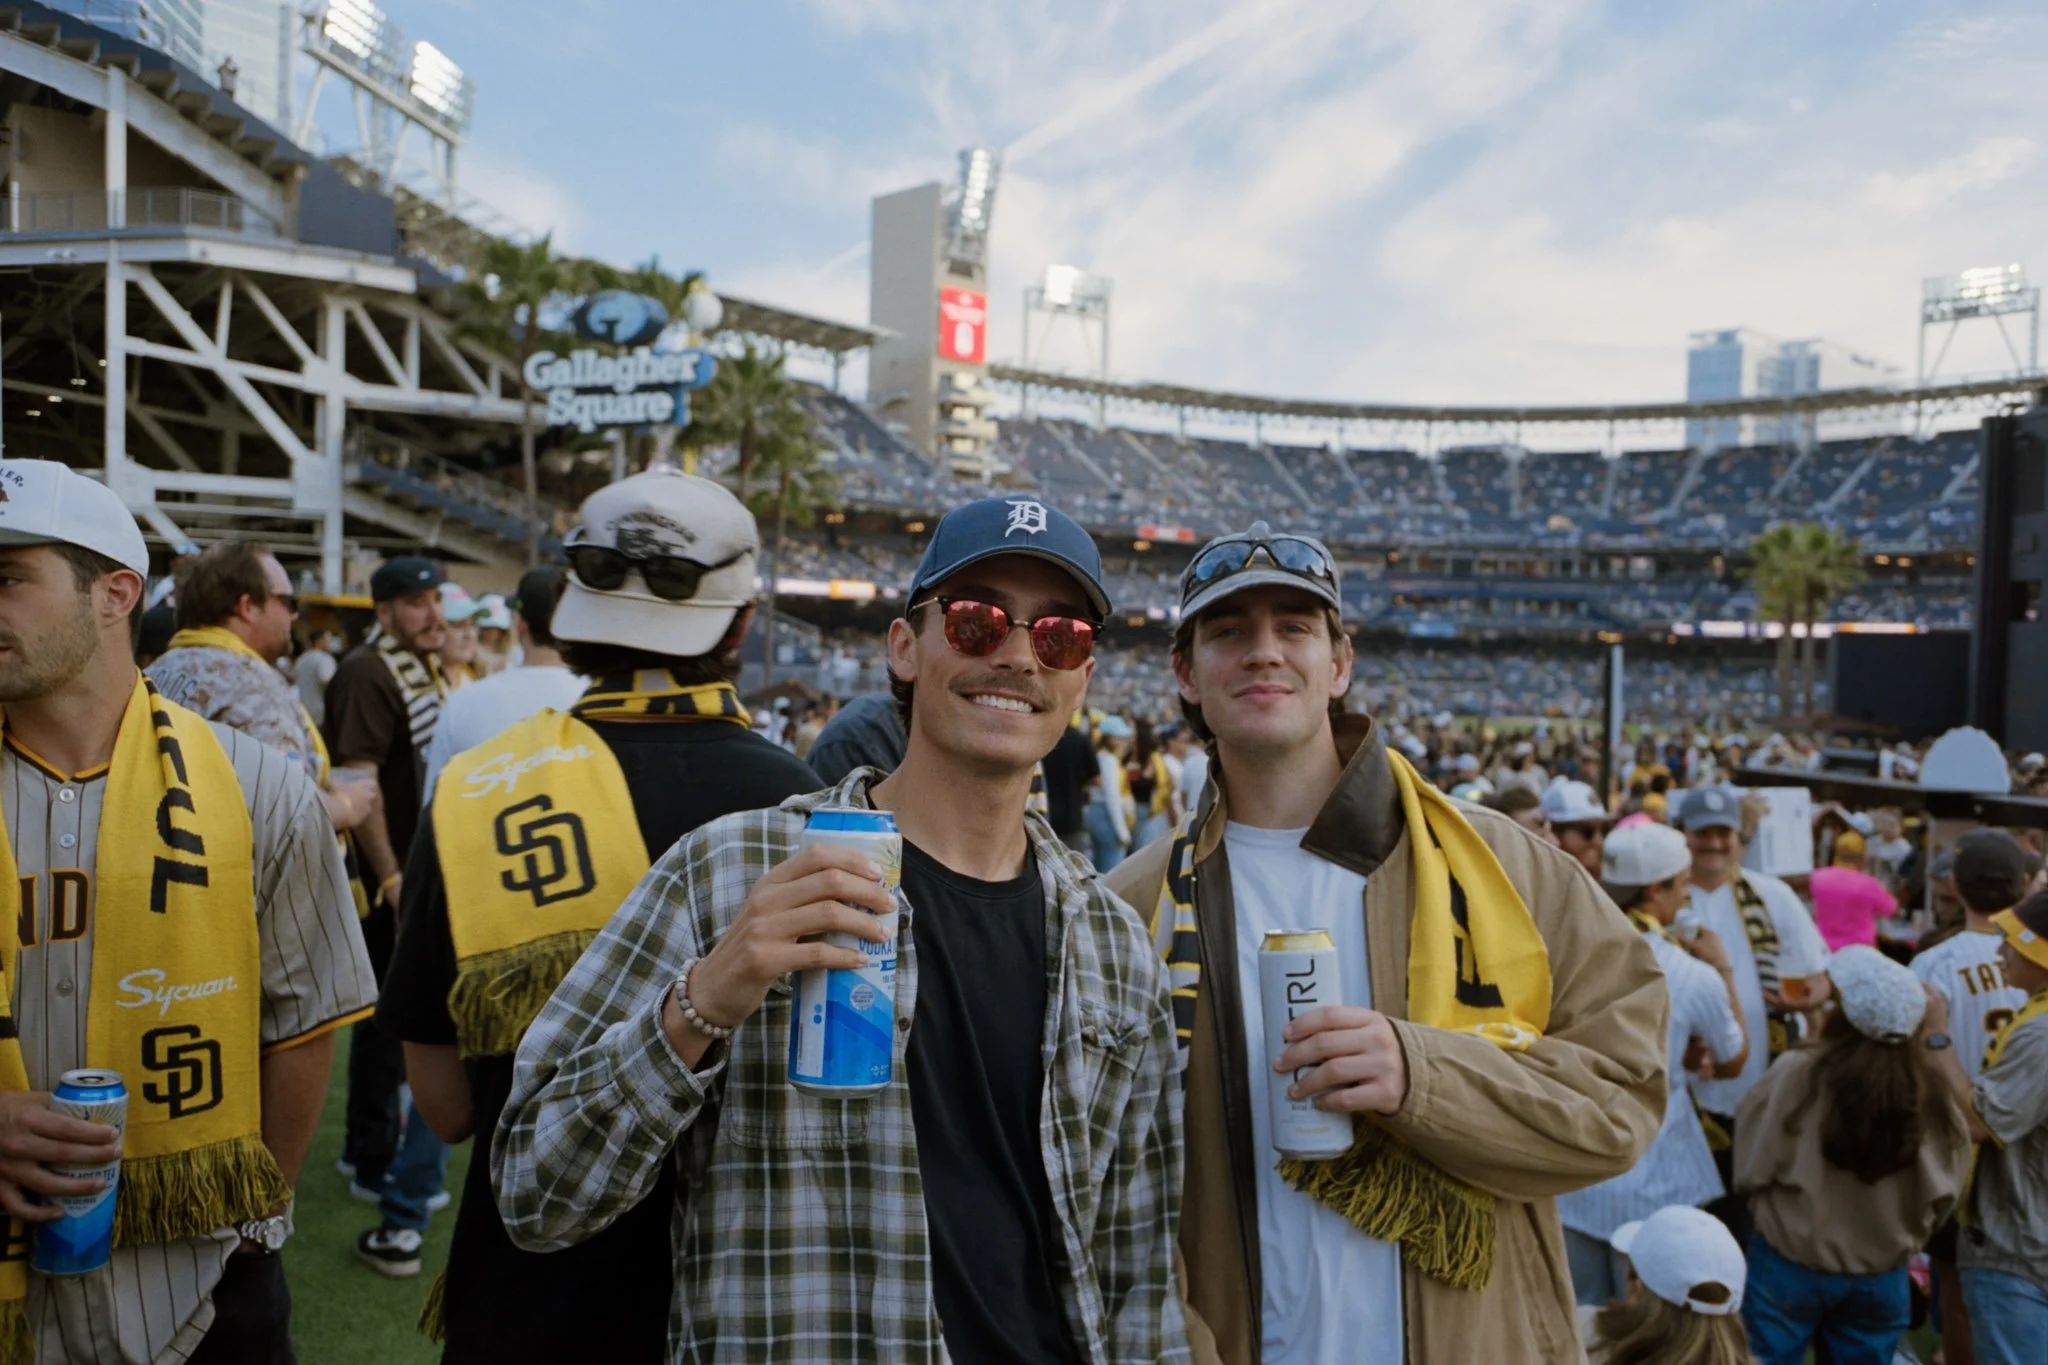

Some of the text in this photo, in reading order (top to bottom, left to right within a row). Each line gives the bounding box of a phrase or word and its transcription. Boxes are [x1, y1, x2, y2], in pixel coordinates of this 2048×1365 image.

[523, 346, 700, 394] Gallagher
[547, 388, 675, 433] Square
[1005, 500, 1048, 538] D
[115, 968, 238, 1016] Sycuan
[141, 1024, 223, 1120] SD
